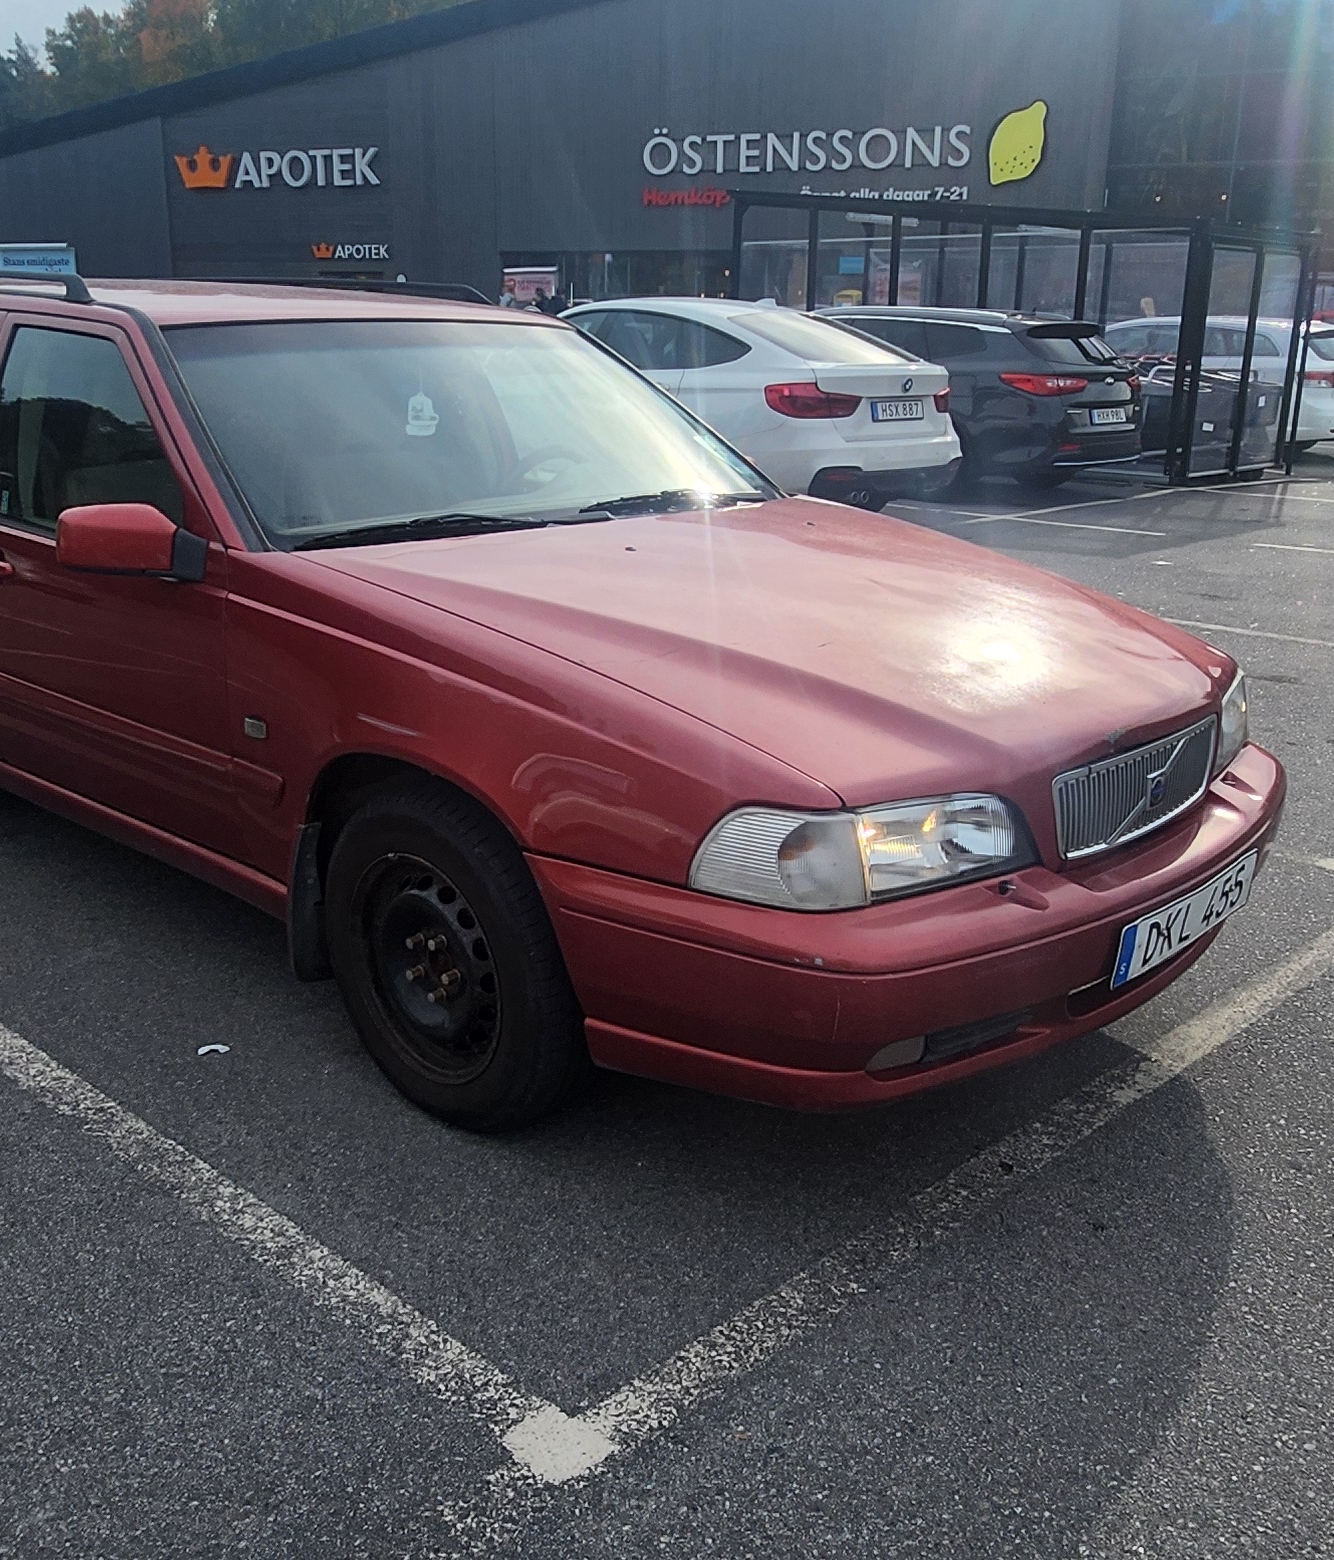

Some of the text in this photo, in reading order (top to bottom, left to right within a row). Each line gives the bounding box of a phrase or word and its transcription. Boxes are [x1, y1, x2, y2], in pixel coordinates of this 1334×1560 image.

[643, 124, 971, 176] ÖSTENSSONS
[234, 147, 380, 188] APOTEK
[643, 185, 730, 208] Hemköp
[934, 186, 968, 200] 7-21
[334, 244, 389, 259] APOTEK
[881, 402, 920, 418] HSX 887
[1141, 864, 1245, 968] DKL 455
[1119, 963, 1127, 975] S
